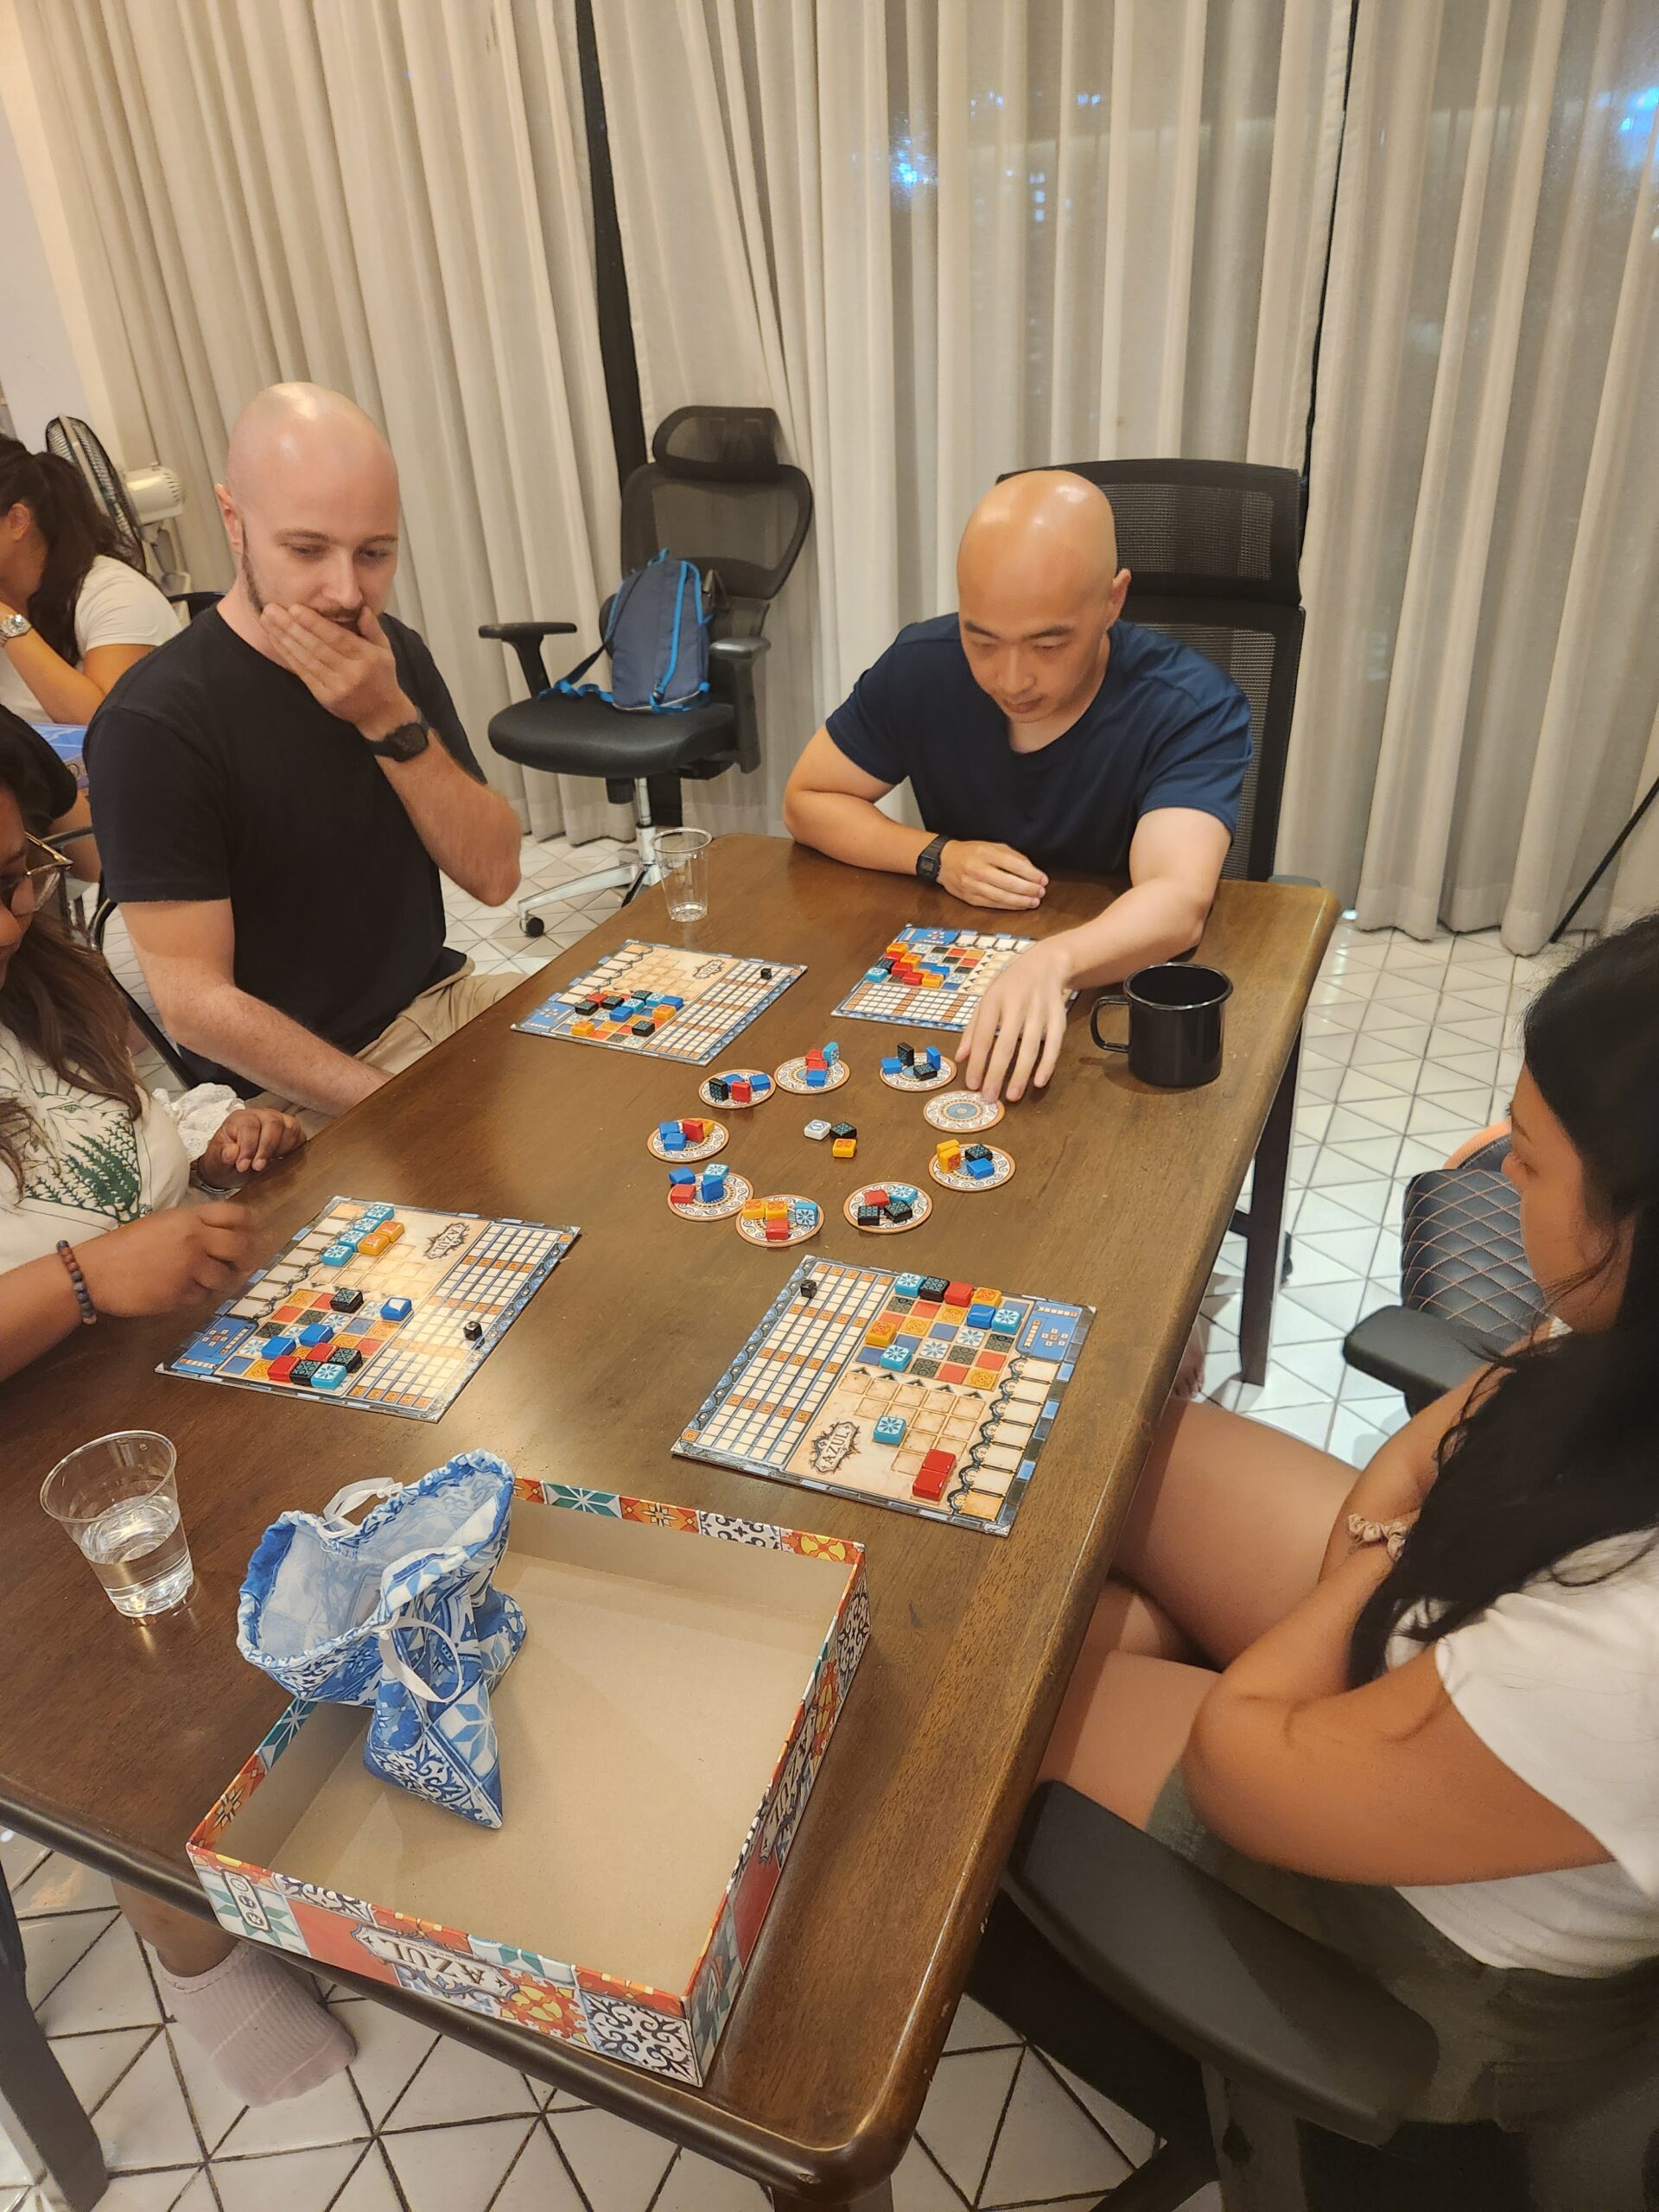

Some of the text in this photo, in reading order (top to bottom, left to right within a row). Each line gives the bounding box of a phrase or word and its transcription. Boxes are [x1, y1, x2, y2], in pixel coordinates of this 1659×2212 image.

[433, 1228, 459, 1252] AZUL
[823, 1433, 850, 1465] AZUL
[378, 1936, 485, 1985] AZUL
